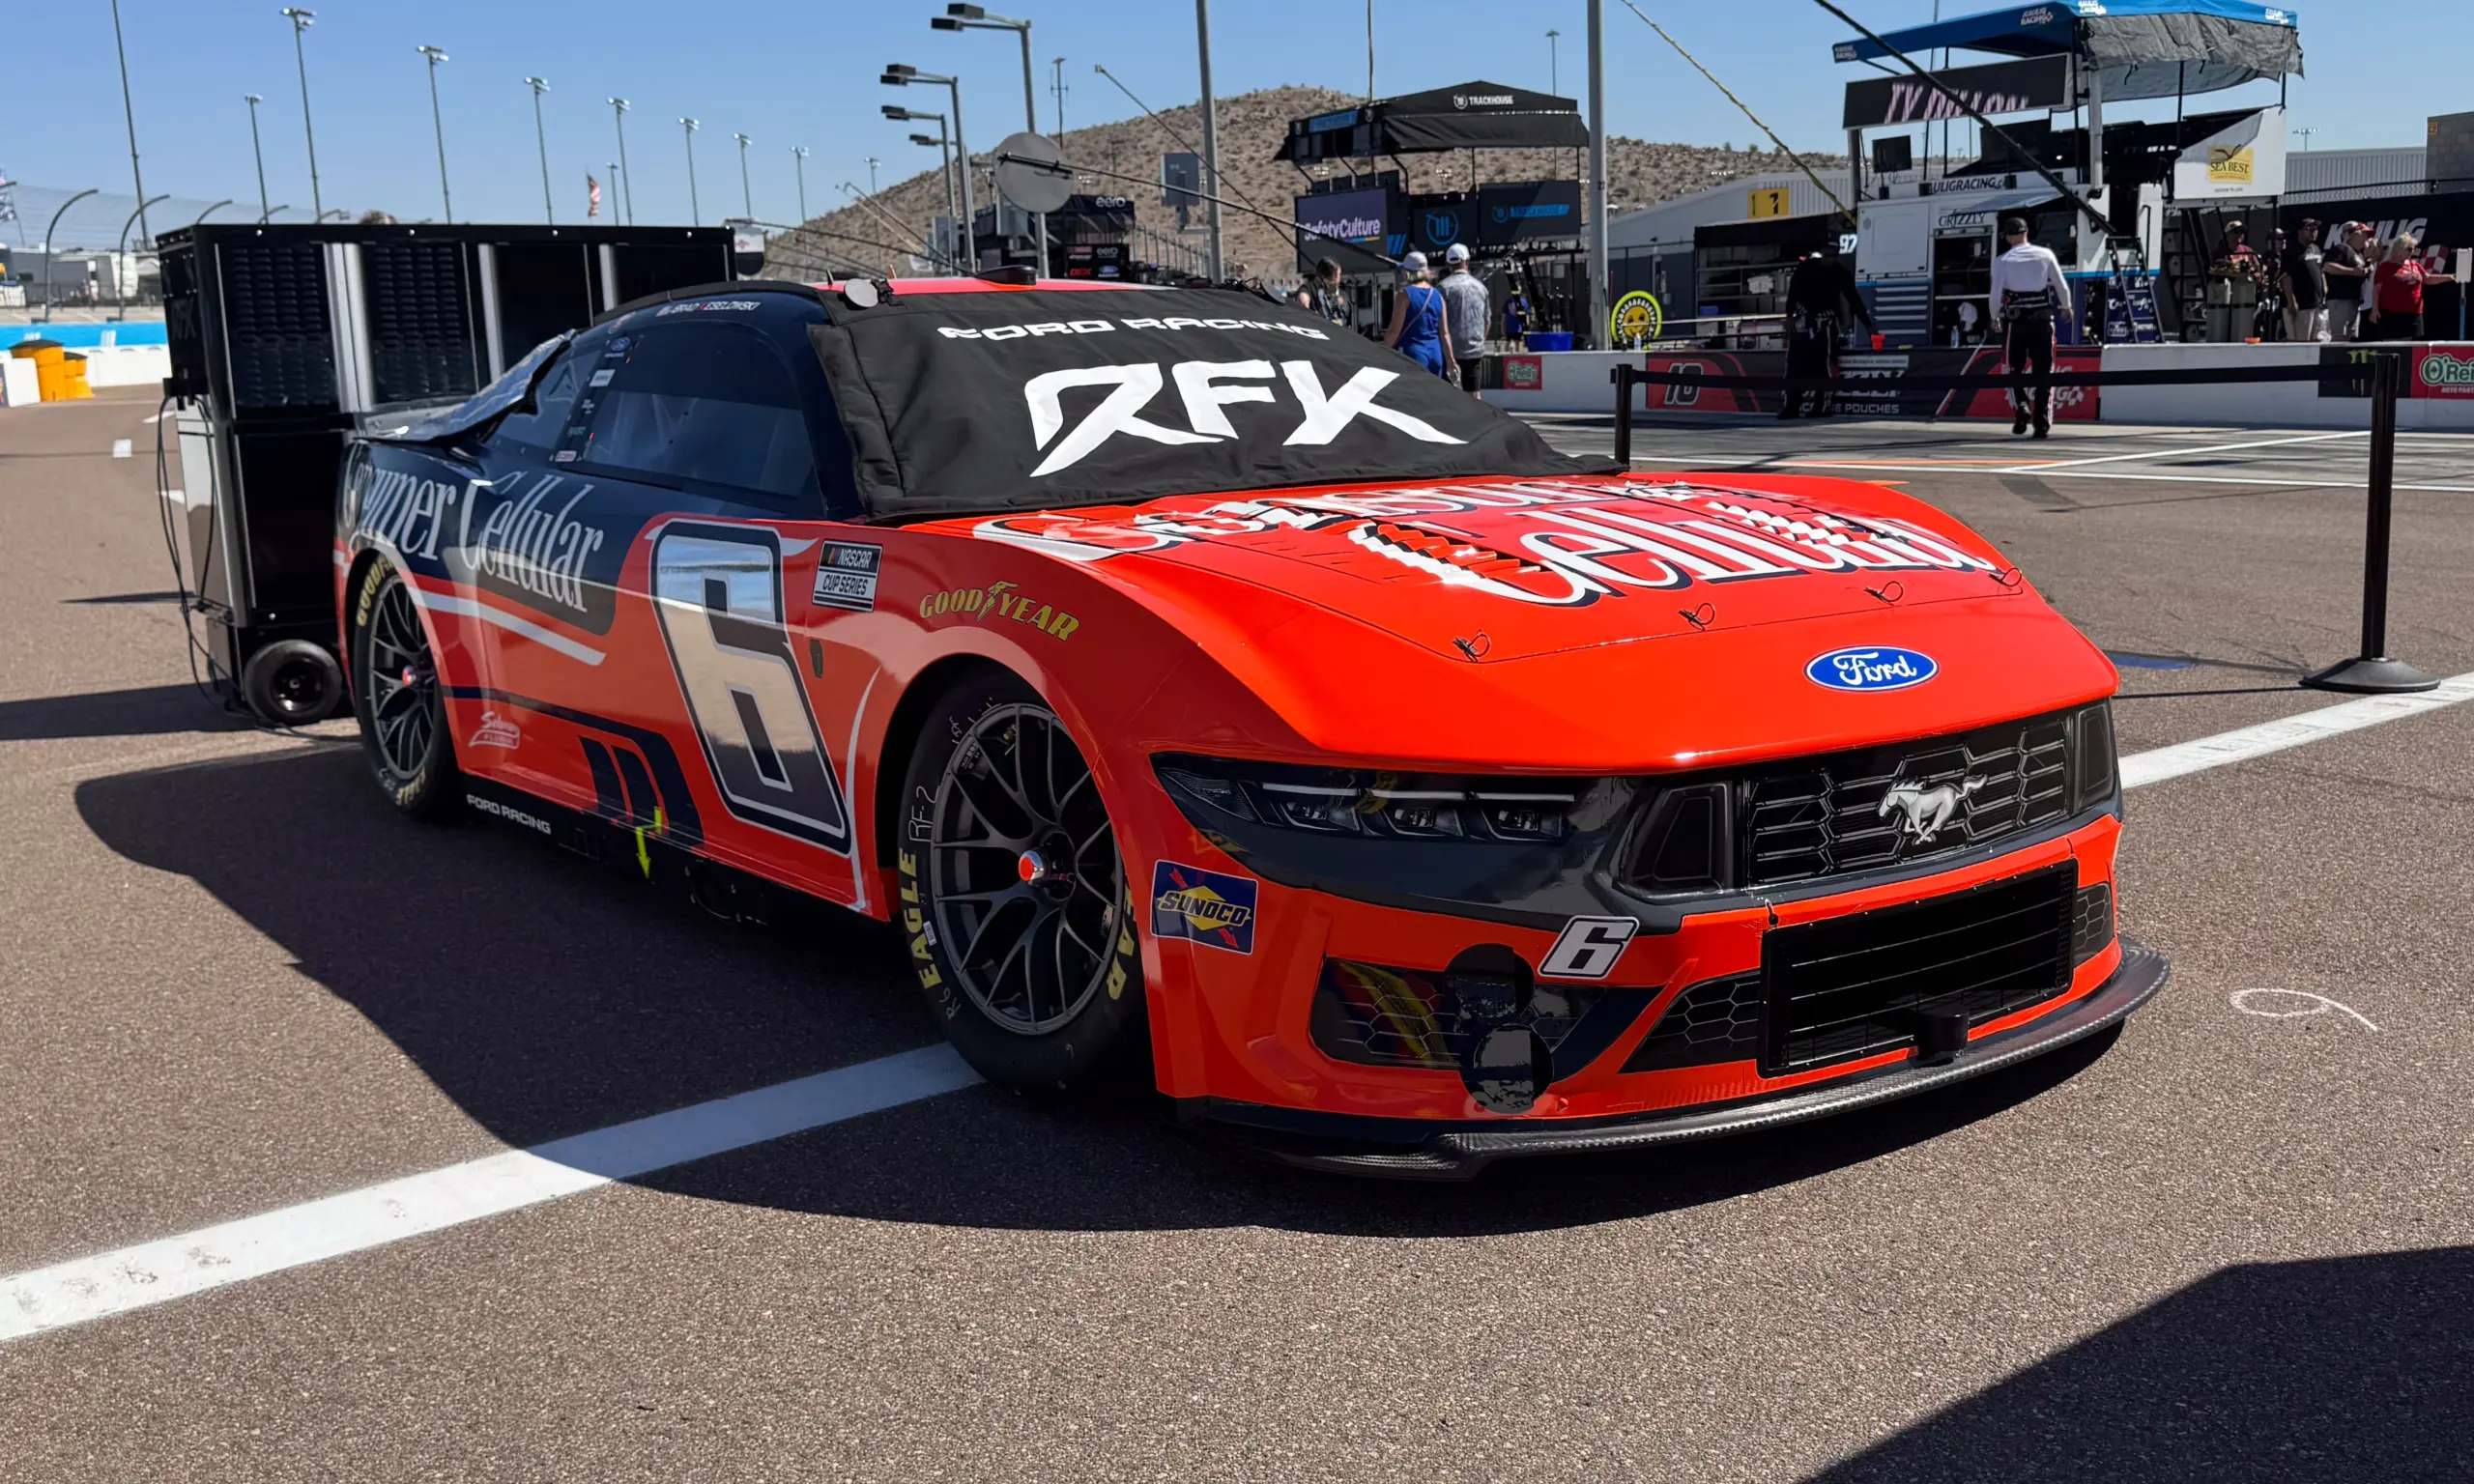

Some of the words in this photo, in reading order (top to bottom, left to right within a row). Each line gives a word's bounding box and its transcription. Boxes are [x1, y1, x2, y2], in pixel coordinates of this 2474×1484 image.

[1469, 95, 1513, 105] TRACKHOUSE
[2210, 161, 2226, 172] SEA
[2228, 161, 2249, 174] BEST
[1096, 196, 1126, 208] eero
[1939, 212, 1986, 227] GRIZZLY
[1838, 234, 1857, 254] 97
[936, 319, 1116, 341] FORD
[1121, 317, 1331, 341] RACING
[1024, 359, 1469, 478] RFK
[1845, 403, 1900, 414] POUCHES
[837, 547, 873, 569] NASCAR
[822, 574, 841, 591] CUP
[839, 576, 868, 596] SERIES
[1832, 651, 1917, 686] Ford
[651, 522, 849, 856] 6
[466, 793, 501, 815] FORD
[501, 805, 551, 836] RACING
[899, 847, 943, 990] EAGLE
[1161, 892, 1248, 926] SUNOCO
[1538, 916, 1639, 979] 6
